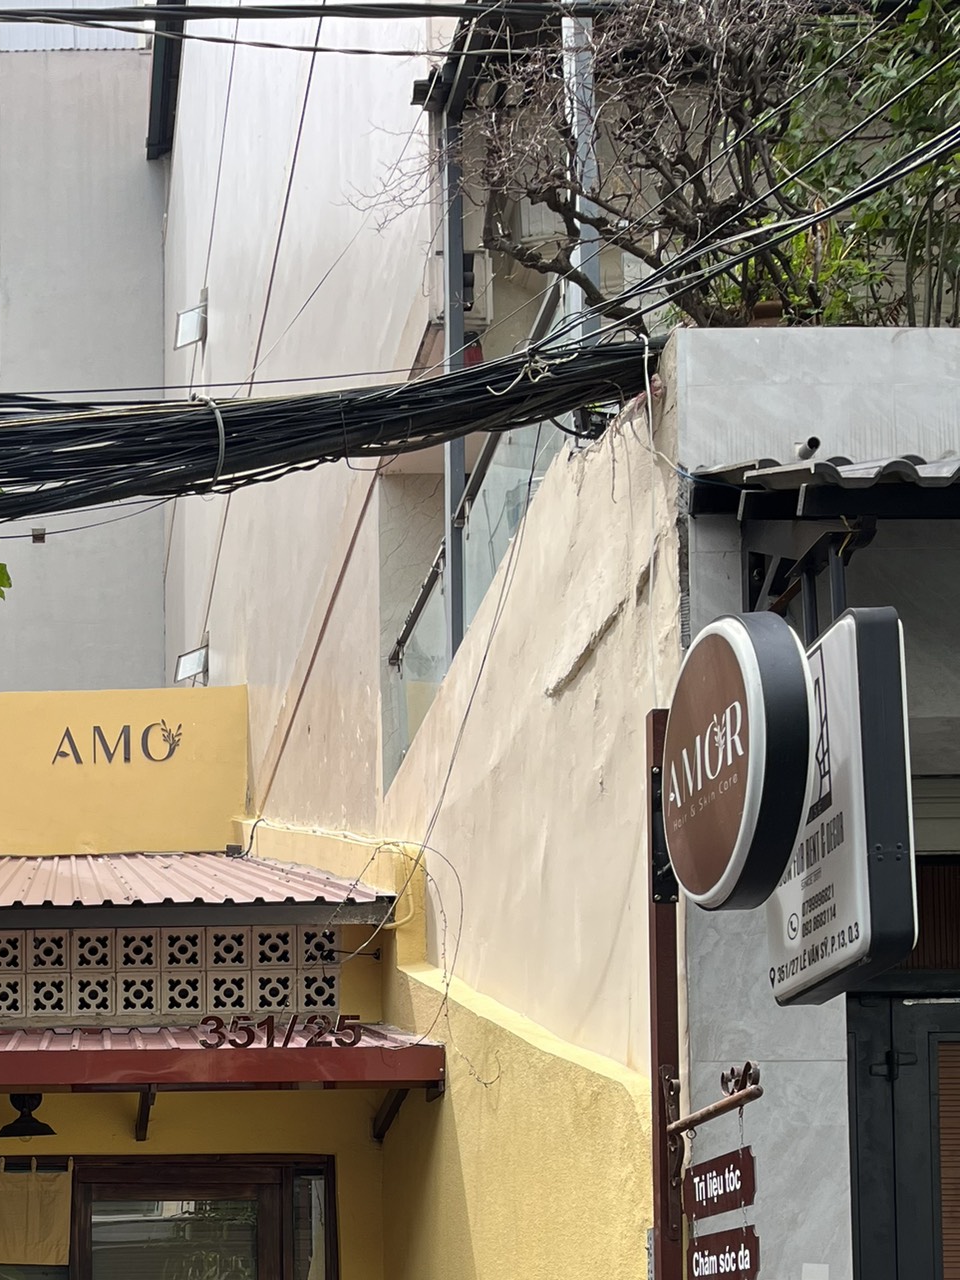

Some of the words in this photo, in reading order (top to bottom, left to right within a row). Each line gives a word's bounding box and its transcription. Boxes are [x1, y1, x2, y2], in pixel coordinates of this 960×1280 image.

[51, 718, 183, 765] AMO
[667, 701, 744, 817] AMOR
[673, 813, 688, 832] Hair
[690, 804, 696, 818] &
[699, 791, 716, 812] Skin
[718, 773, 739, 795] Care
[777, 956, 799, 984] 351/27
[198, 1014, 363, 1050] 351/25
[693, 1174, 707, 1206] Trị
[706, 1170, 724, 1203] liệu
[725, 1164, 741, 1193] tóc
[692, 1249, 718, 1277] Chăm
[718, 1245, 737, 1273] sóc
[737, 1243, 751, 1270] da
